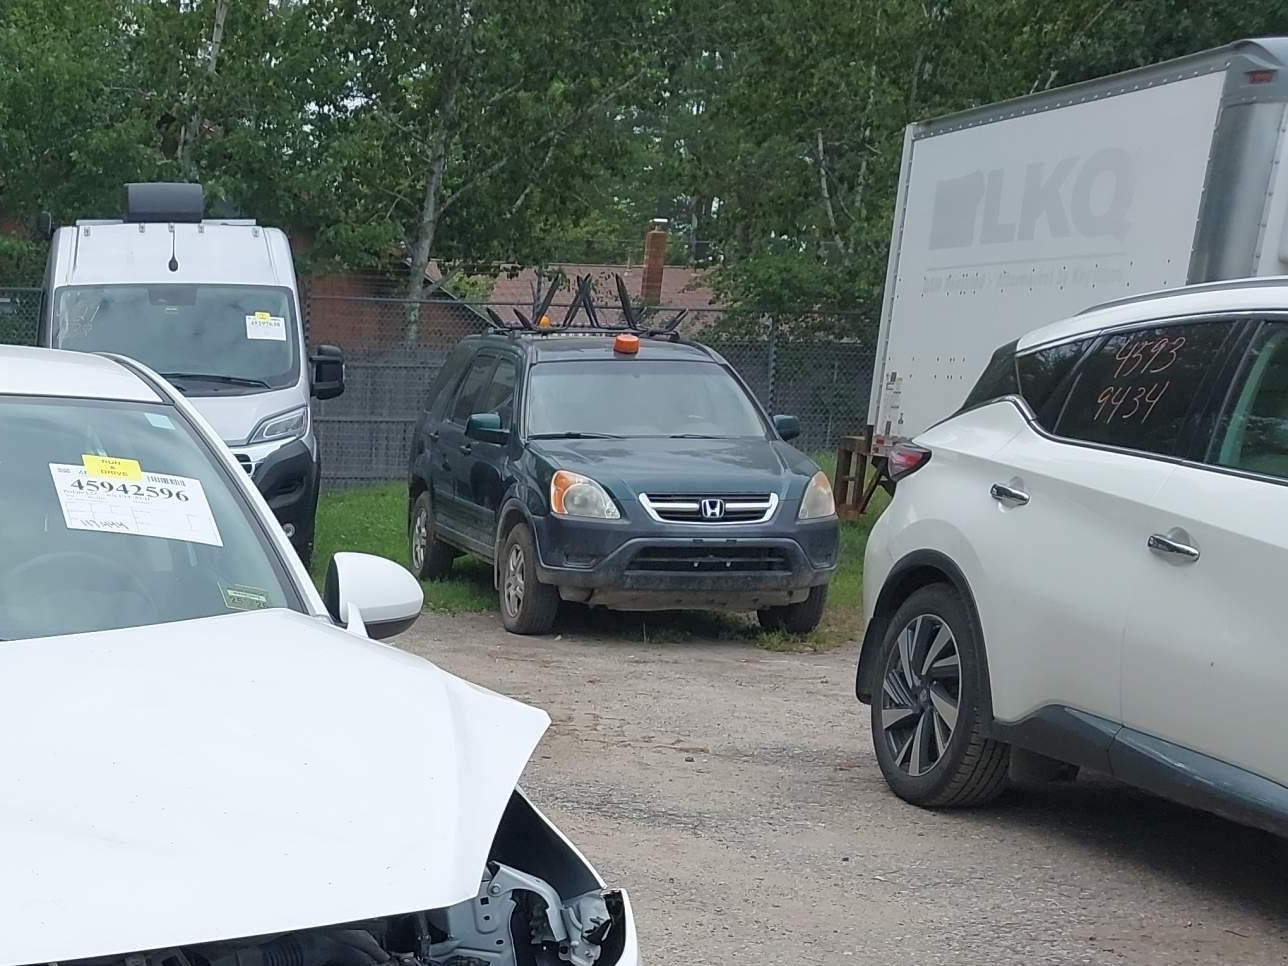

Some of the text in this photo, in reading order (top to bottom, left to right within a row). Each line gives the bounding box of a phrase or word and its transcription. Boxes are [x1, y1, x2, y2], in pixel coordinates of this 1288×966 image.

[980, 148, 1136, 245] LKQ
[1114, 336, 1186, 378] 4593
[1094, 381, 1170, 424] 9434
[70, 478, 190, 503] 45942596
